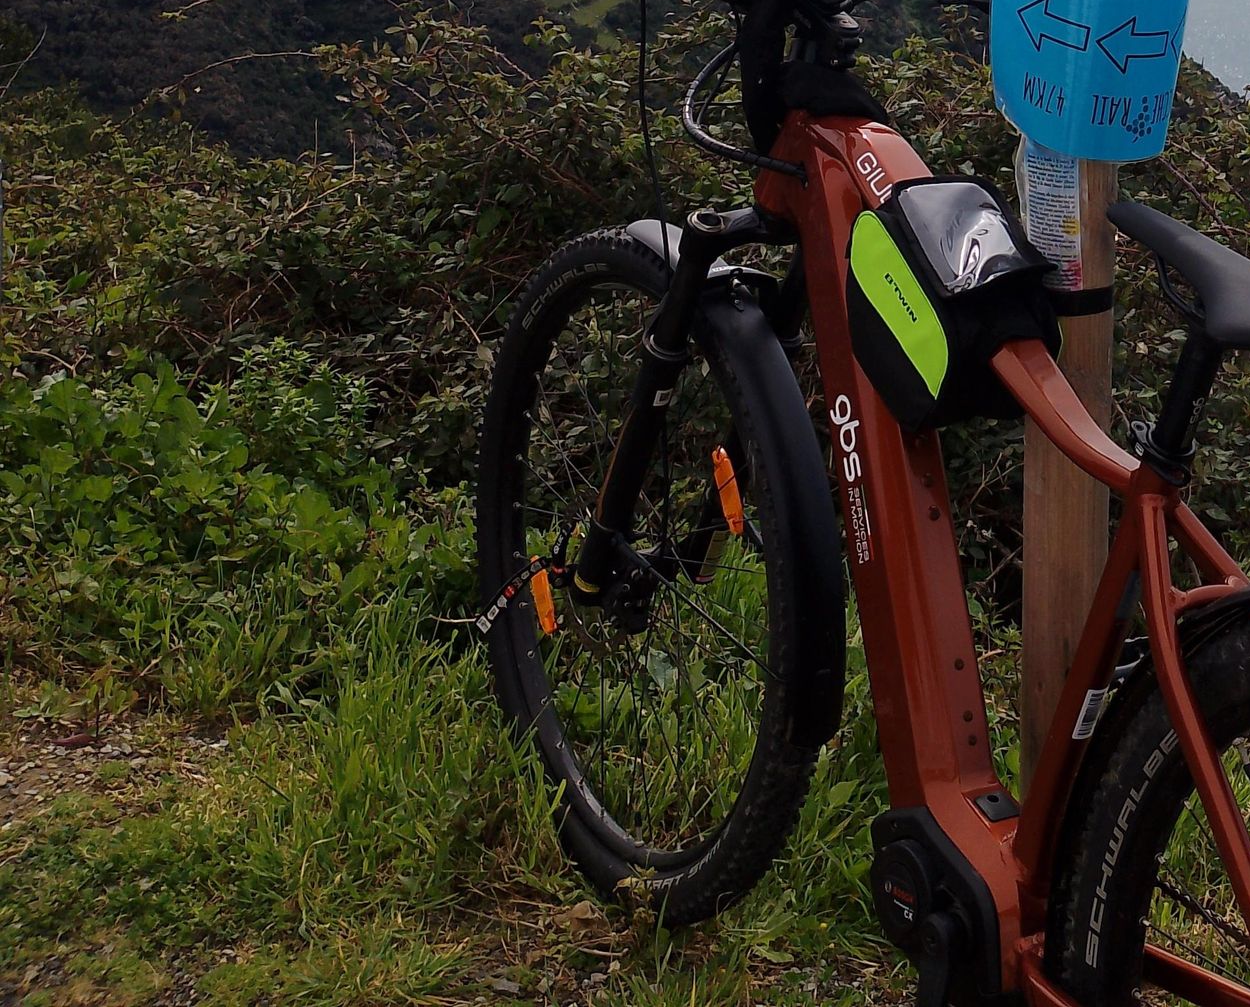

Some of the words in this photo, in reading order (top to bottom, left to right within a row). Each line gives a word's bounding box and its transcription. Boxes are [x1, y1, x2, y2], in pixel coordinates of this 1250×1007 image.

[1091, 94, 1132, 127] RAIL
[847, 487, 855, 502] IN
[850, 506, 865, 564] MOTION
[854, 487, 870, 561] SERVICES
[1085, 728, 1180, 969] SCHWALBE
